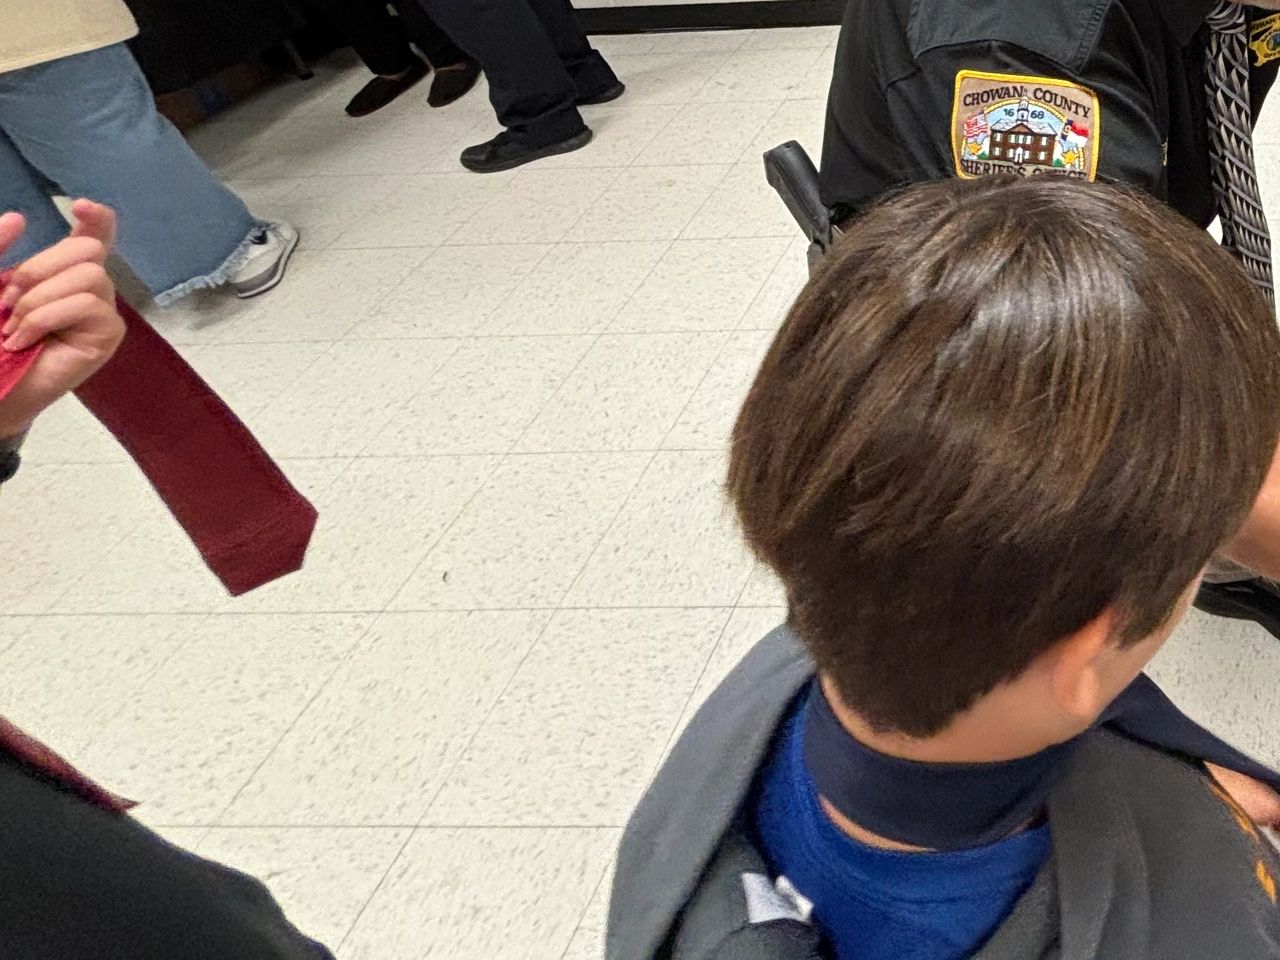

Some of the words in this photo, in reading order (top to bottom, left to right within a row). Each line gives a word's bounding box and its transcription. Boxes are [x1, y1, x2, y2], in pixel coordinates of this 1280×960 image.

[963, 85, 1025, 106] CHOWAN
[1033, 88, 1092, 118] COUNTY
[1003, 108, 1015, 117] 16
[1030, 110, 1045, 119] 68
